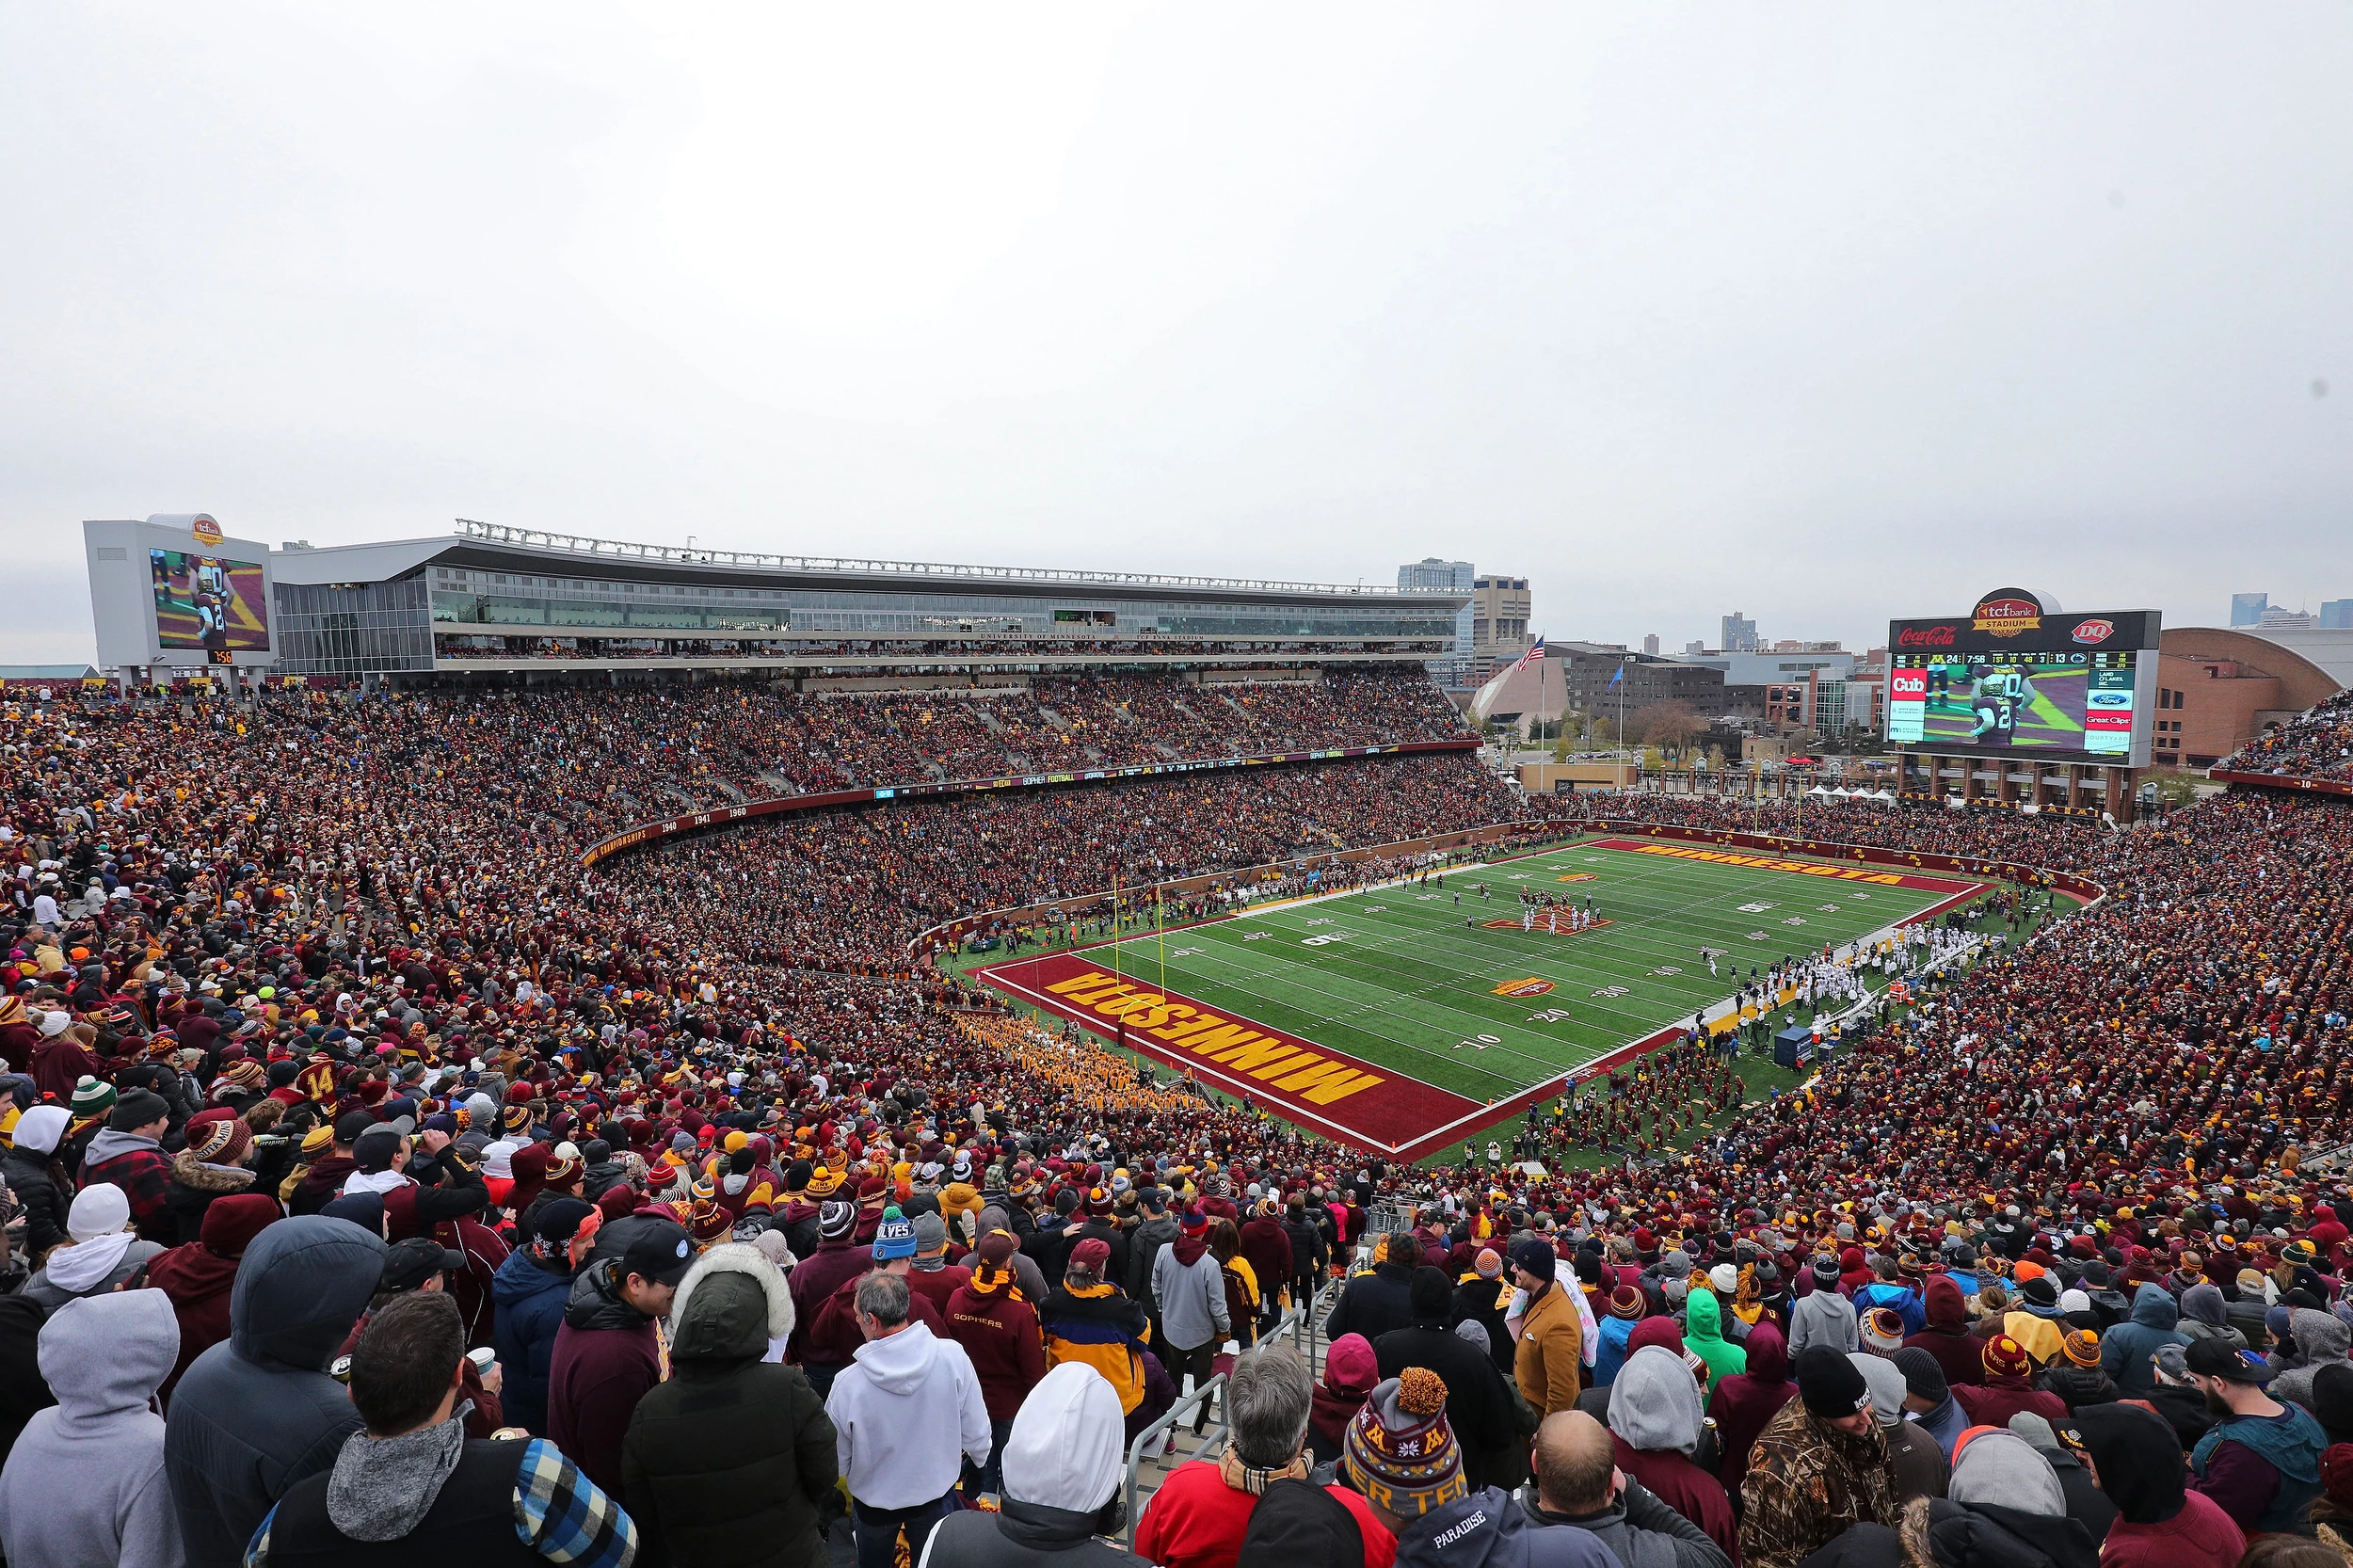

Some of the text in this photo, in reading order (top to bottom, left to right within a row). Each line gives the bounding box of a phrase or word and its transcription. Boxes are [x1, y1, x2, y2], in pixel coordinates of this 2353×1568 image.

[1898, 626, 1957, 647] Coca-Cola
[2078, 624, 2107, 639] DQ
[1946, 654, 1959, 664] 24
[2056, 654, 2066, 664] 13
[1893, 677, 1925, 693] Cub
[2098, 696, 2121, 704] Ford
[1998, 706, 2010, 729] 2
[2086, 715, 2130, 726] Great Clips
[1023, 776, 1046, 786] GOPHER
[1048, 774, 1075, 783] FOOTBALL
[2301, 780, 2312, 789] 10
[695, 814, 711, 825] 1941
[729, 807, 747, 818] 1960
[662, 822, 678, 833] 1940
[600, 829, 648, 856] CHAMPIONSHIPS
[1632, 845, 1904, 886] MINNESOTA
[1173, 946, 1207, 956] 10
[1653, 965, 1683, 977] 40
[1594, 985, 1631, 999] 30
[1532, 1008, 1571, 1023] 20
[1041, 972, 1386, 1106] MINNESOTA
[1460, 1033, 1502, 1050] 10
[307, 1064, 335, 1100] 14
[702, 1212, 722, 1227] UMD
[953, 1313, 1006, 1330] GOPHERS
[1433, 1510, 1487, 1550] PARADISE
